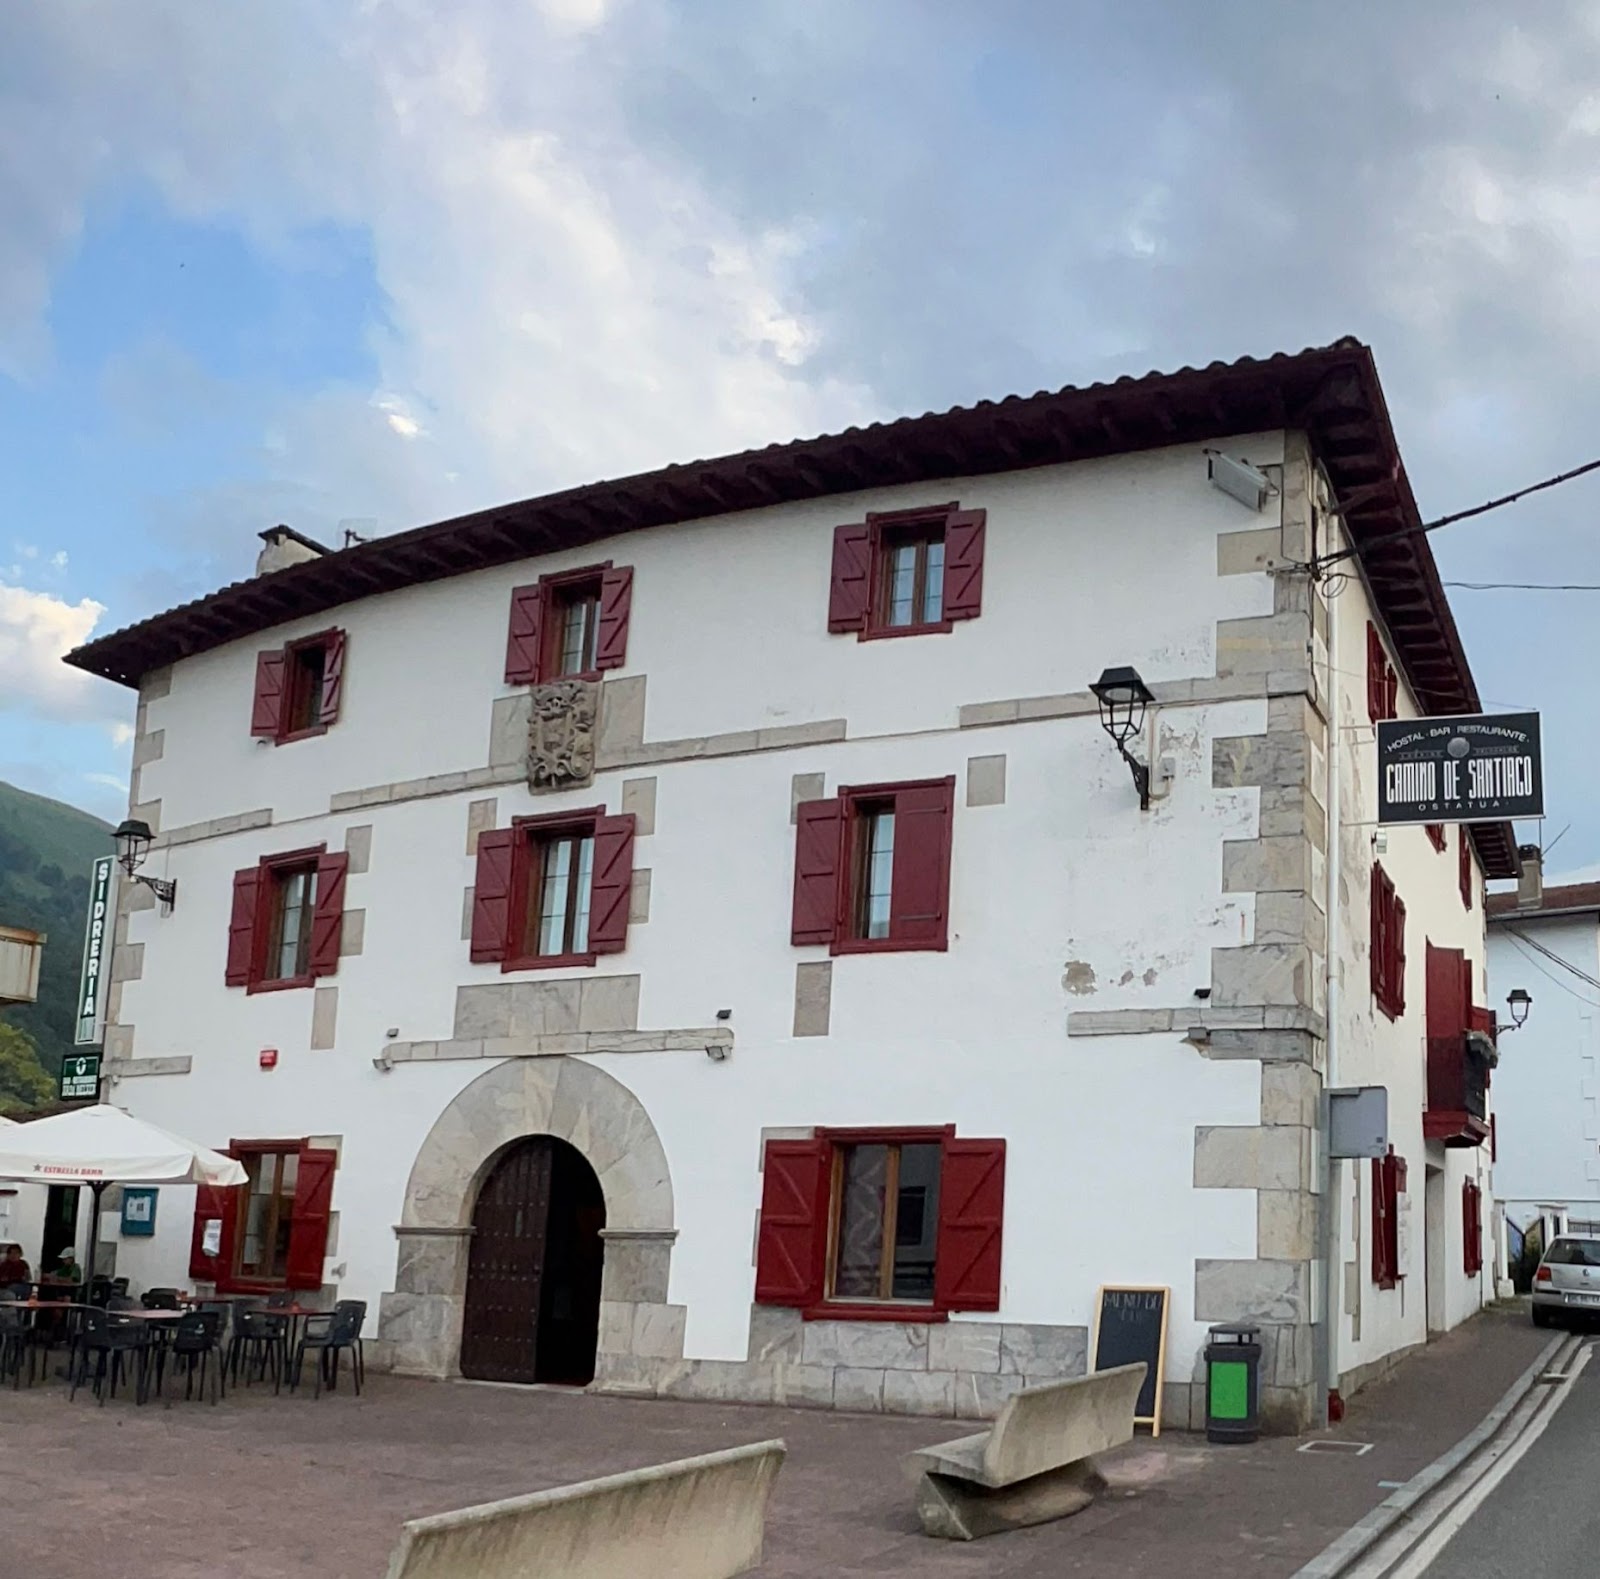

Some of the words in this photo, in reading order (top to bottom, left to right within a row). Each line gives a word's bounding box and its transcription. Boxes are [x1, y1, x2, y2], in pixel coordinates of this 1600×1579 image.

[1387, 732, 1425, 752] HOSTAL
[1430, 726, 1450, 737] BAR
[1457, 725, 1527, 741] RESTAURANTE
[1386, 762, 1436, 803] CAMINO
[1444, 760, 1460, 800] DE
[1468, 756, 1532, 799] SANTIAGO
[1418, 801, 1500, 811] OSTATUA
[83, 863, 108, 1015] SIDRERIA
[44, 1166, 79, 1175] ESTRELLA
